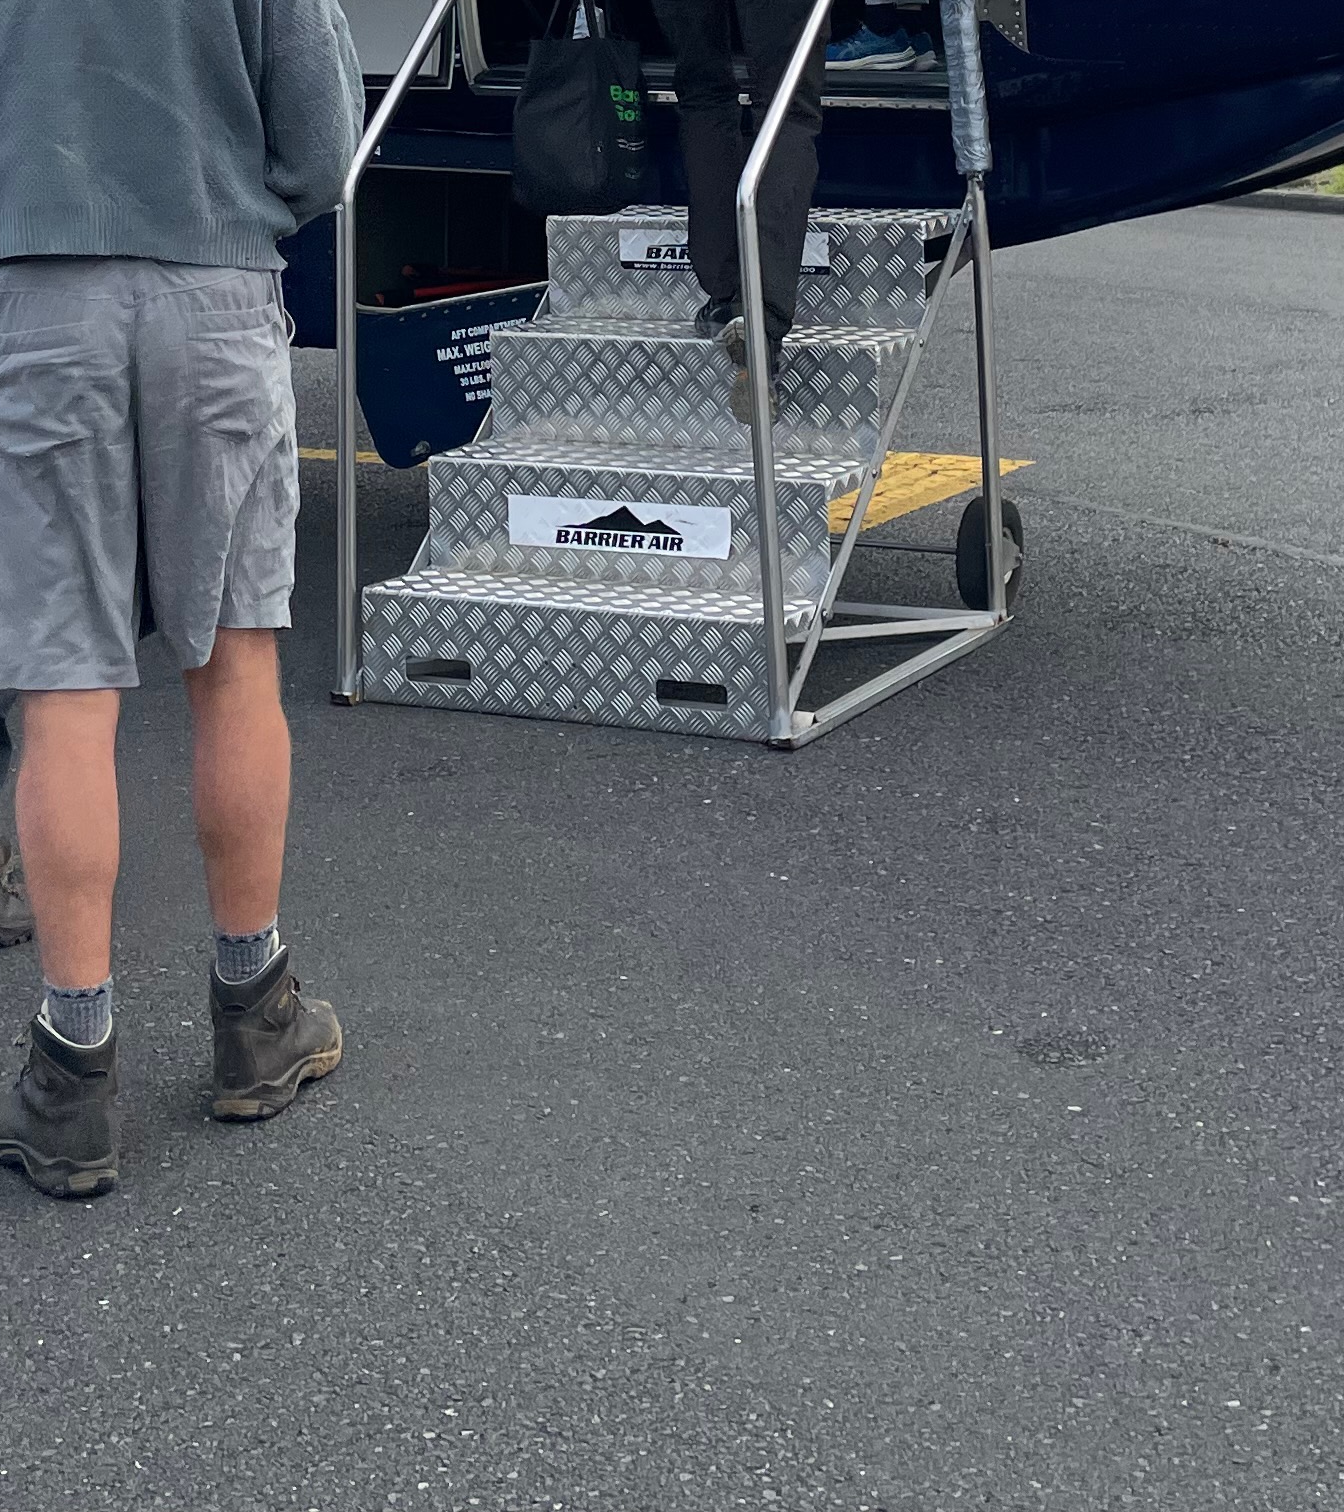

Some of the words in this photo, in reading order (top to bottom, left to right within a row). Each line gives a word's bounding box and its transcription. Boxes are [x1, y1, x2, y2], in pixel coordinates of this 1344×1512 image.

[646, 246, 690, 260] BAR
[451, 329, 467, 340] AFT
[436, 346, 463, 361] MAX.
[464, 341, 492, 357] WEIG
[453, 359, 491, 375] MAX.FLOO
[476, 389, 492, 400] SHA
[555, 529, 646, 550] BARRIER
[647, 535, 684, 552] AIR
